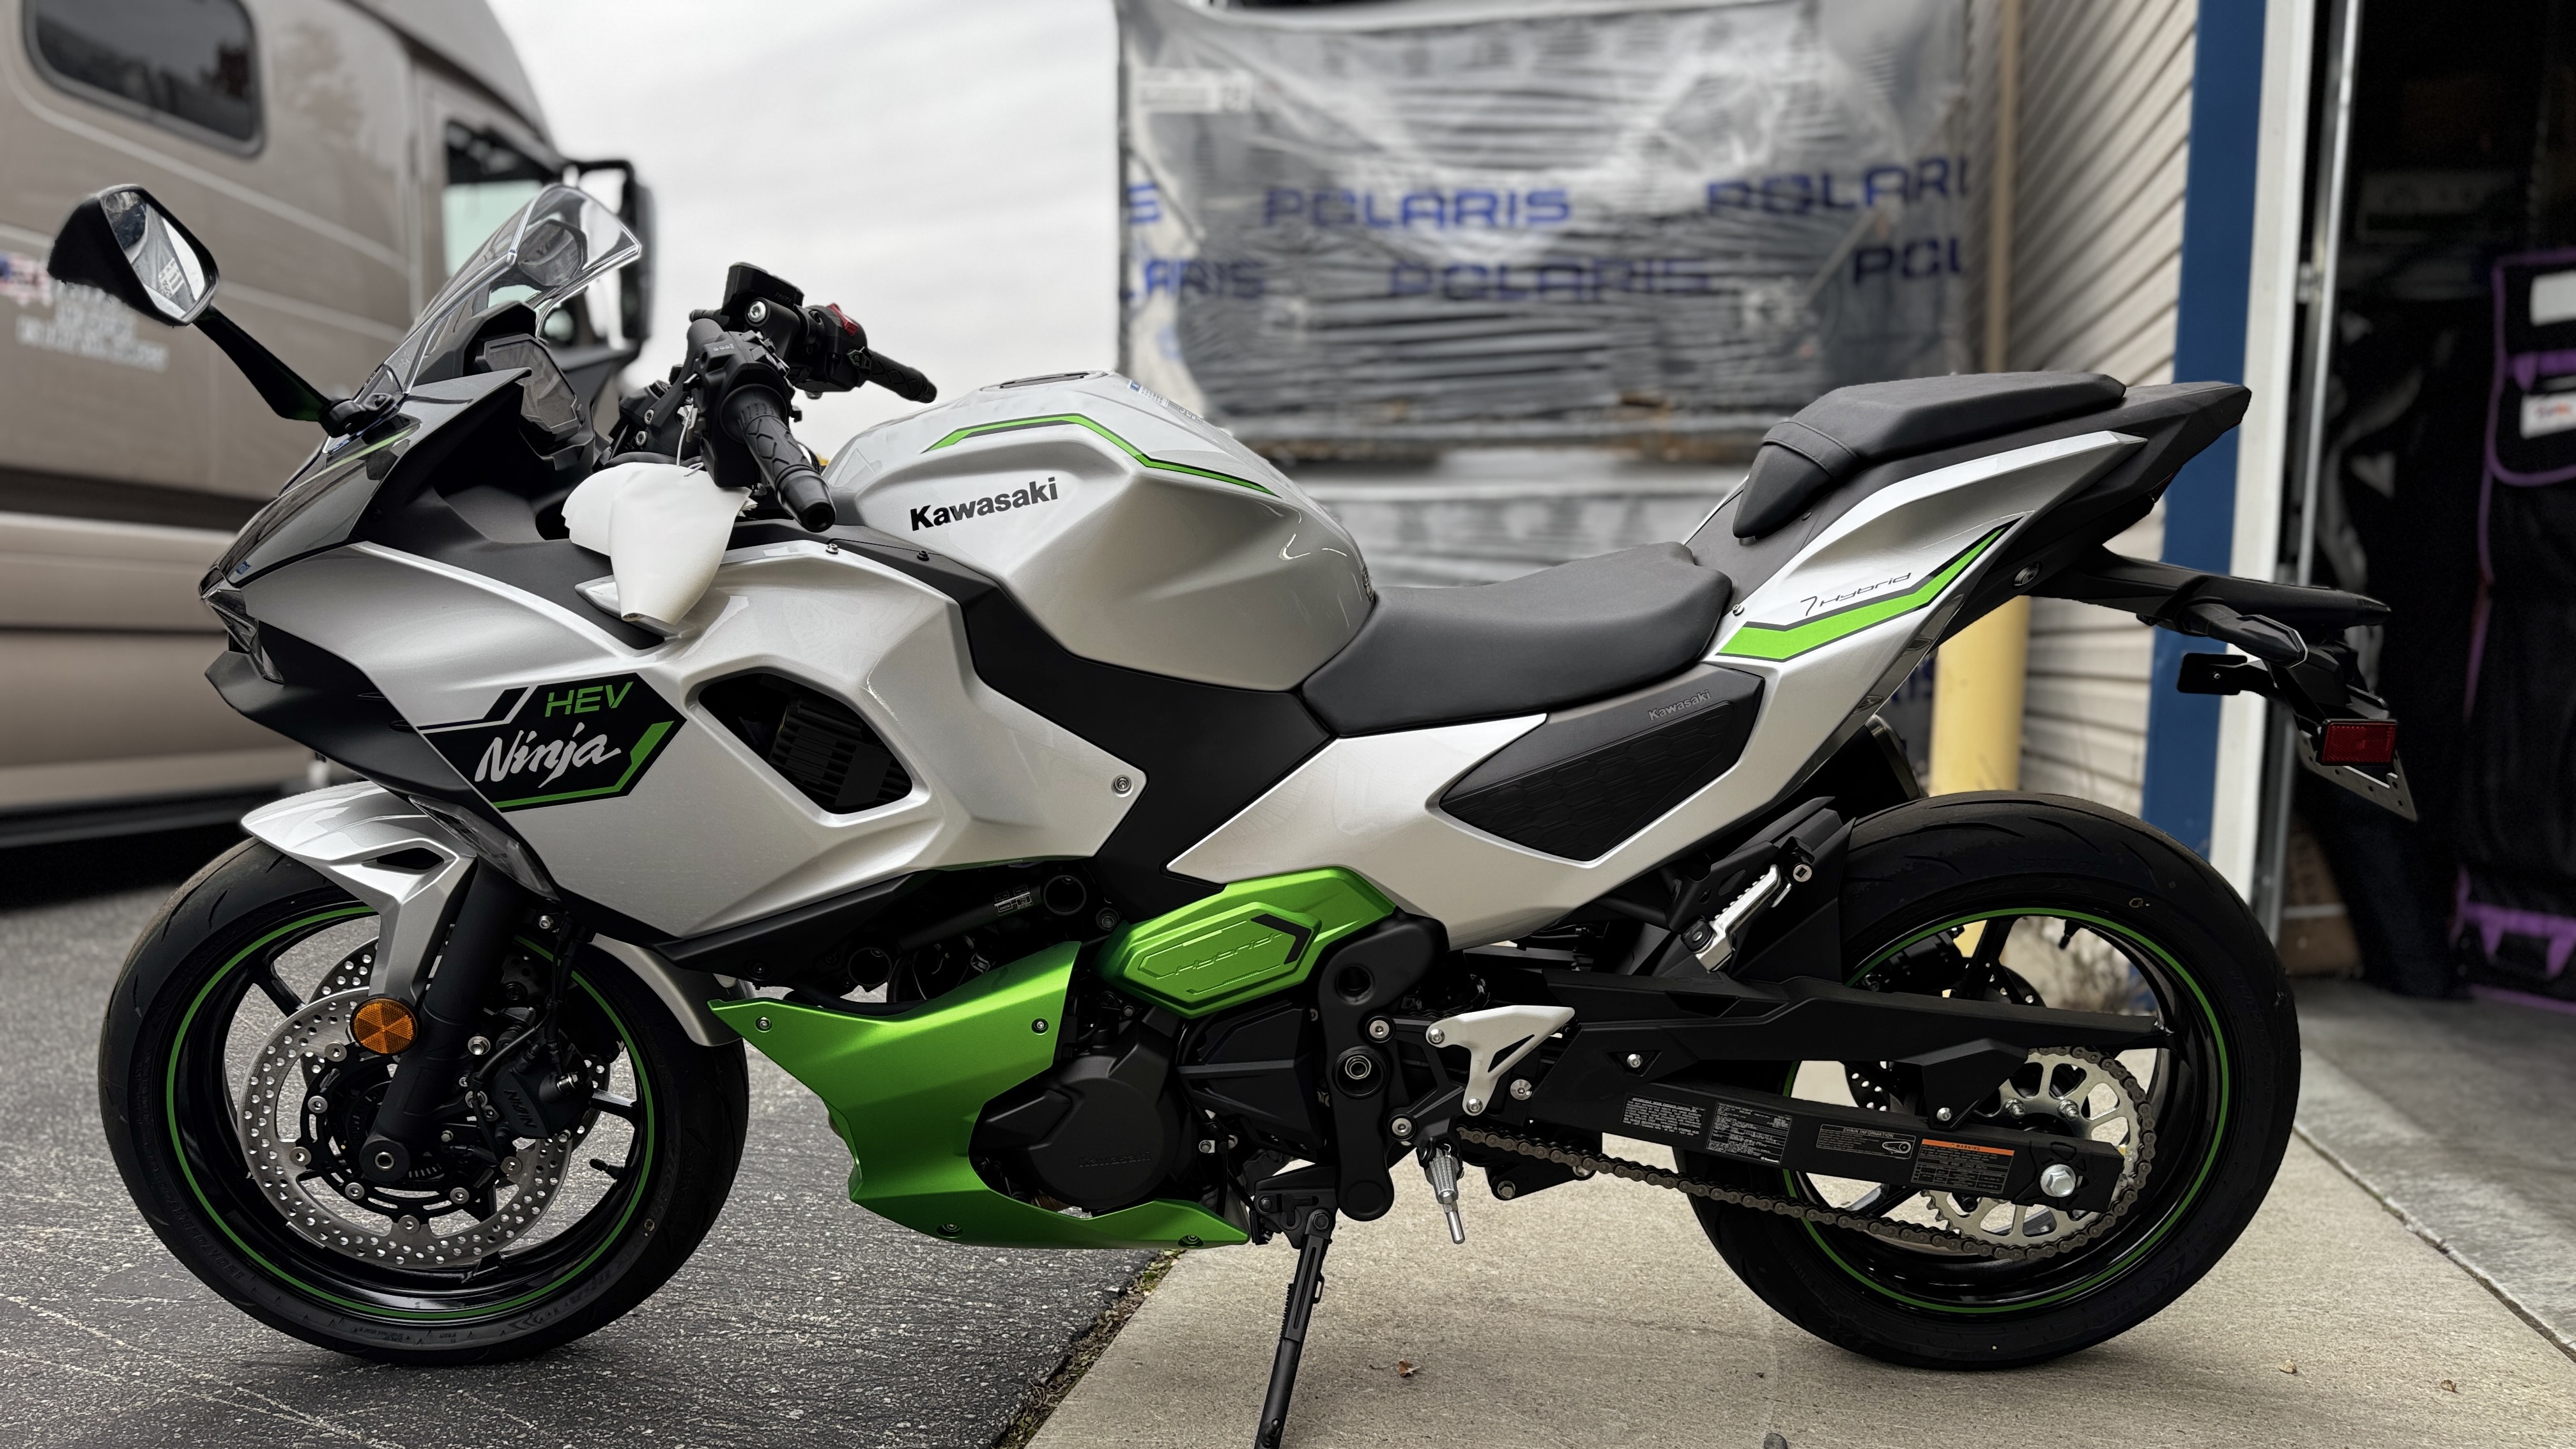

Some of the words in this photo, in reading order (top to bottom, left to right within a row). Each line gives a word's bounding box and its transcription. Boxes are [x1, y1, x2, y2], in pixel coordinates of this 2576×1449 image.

[1262, 187, 1571, 229] POLARIS
[1389, 257, 1711, 303] POLARIS
[910, 477, 1058, 532] Kawasaki
[1819, 572, 1912, 608] Hybrid
[544, 681, 634, 717] HEV
[1648, 689, 1712, 721] Kawasaki
[474, 722, 622, 788] Ninja
